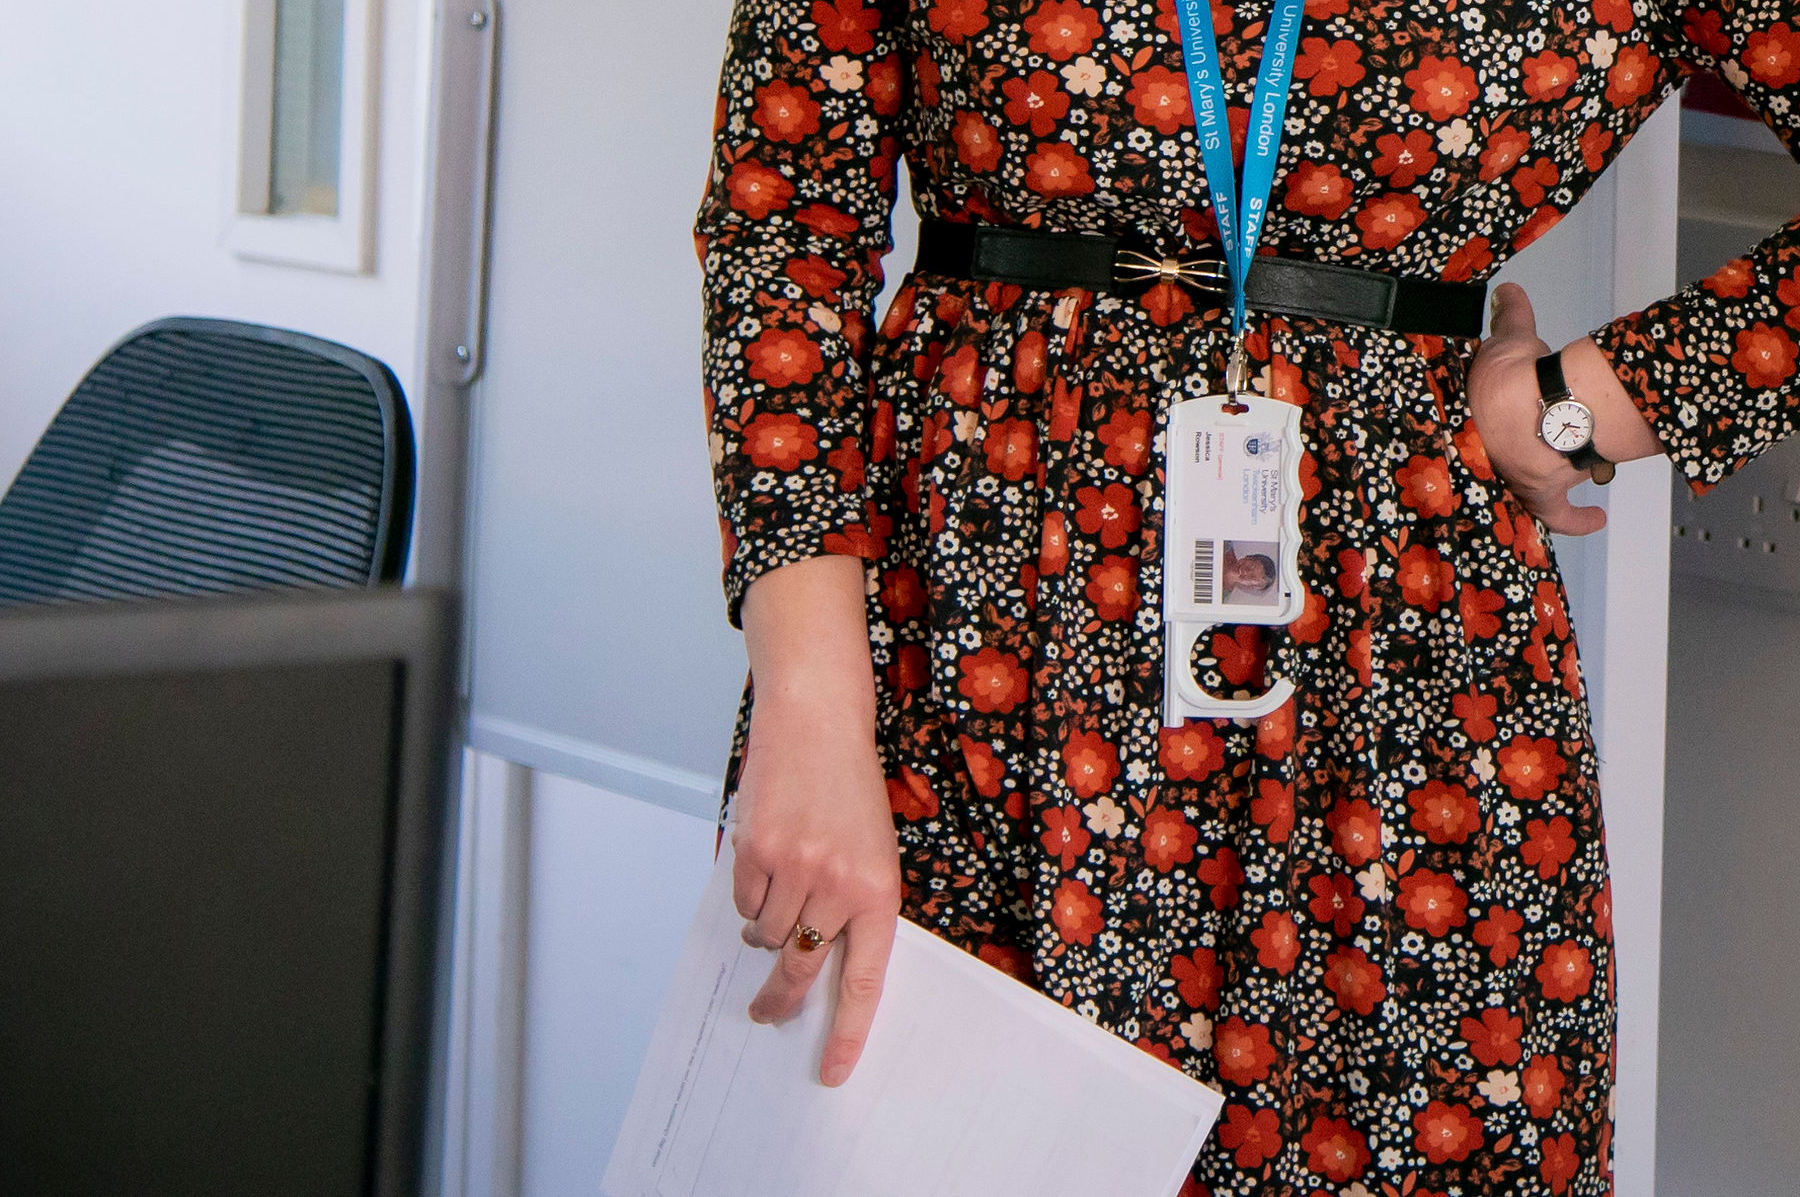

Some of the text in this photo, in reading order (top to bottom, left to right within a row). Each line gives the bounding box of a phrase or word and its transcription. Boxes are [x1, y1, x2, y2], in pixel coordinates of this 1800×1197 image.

[1264, 4, 1297, 89] University
[1194, 66, 1215, 126] Mary's
[1256, 91, 1280, 157] London
[1205, 127, 1221, 151] St
[1215, 192, 1235, 252] STAFF
[1245, 197, 1263, 258] STAFF
[1259, 469, 1269, 515] University
[1271, 469, 1279, 482] St
